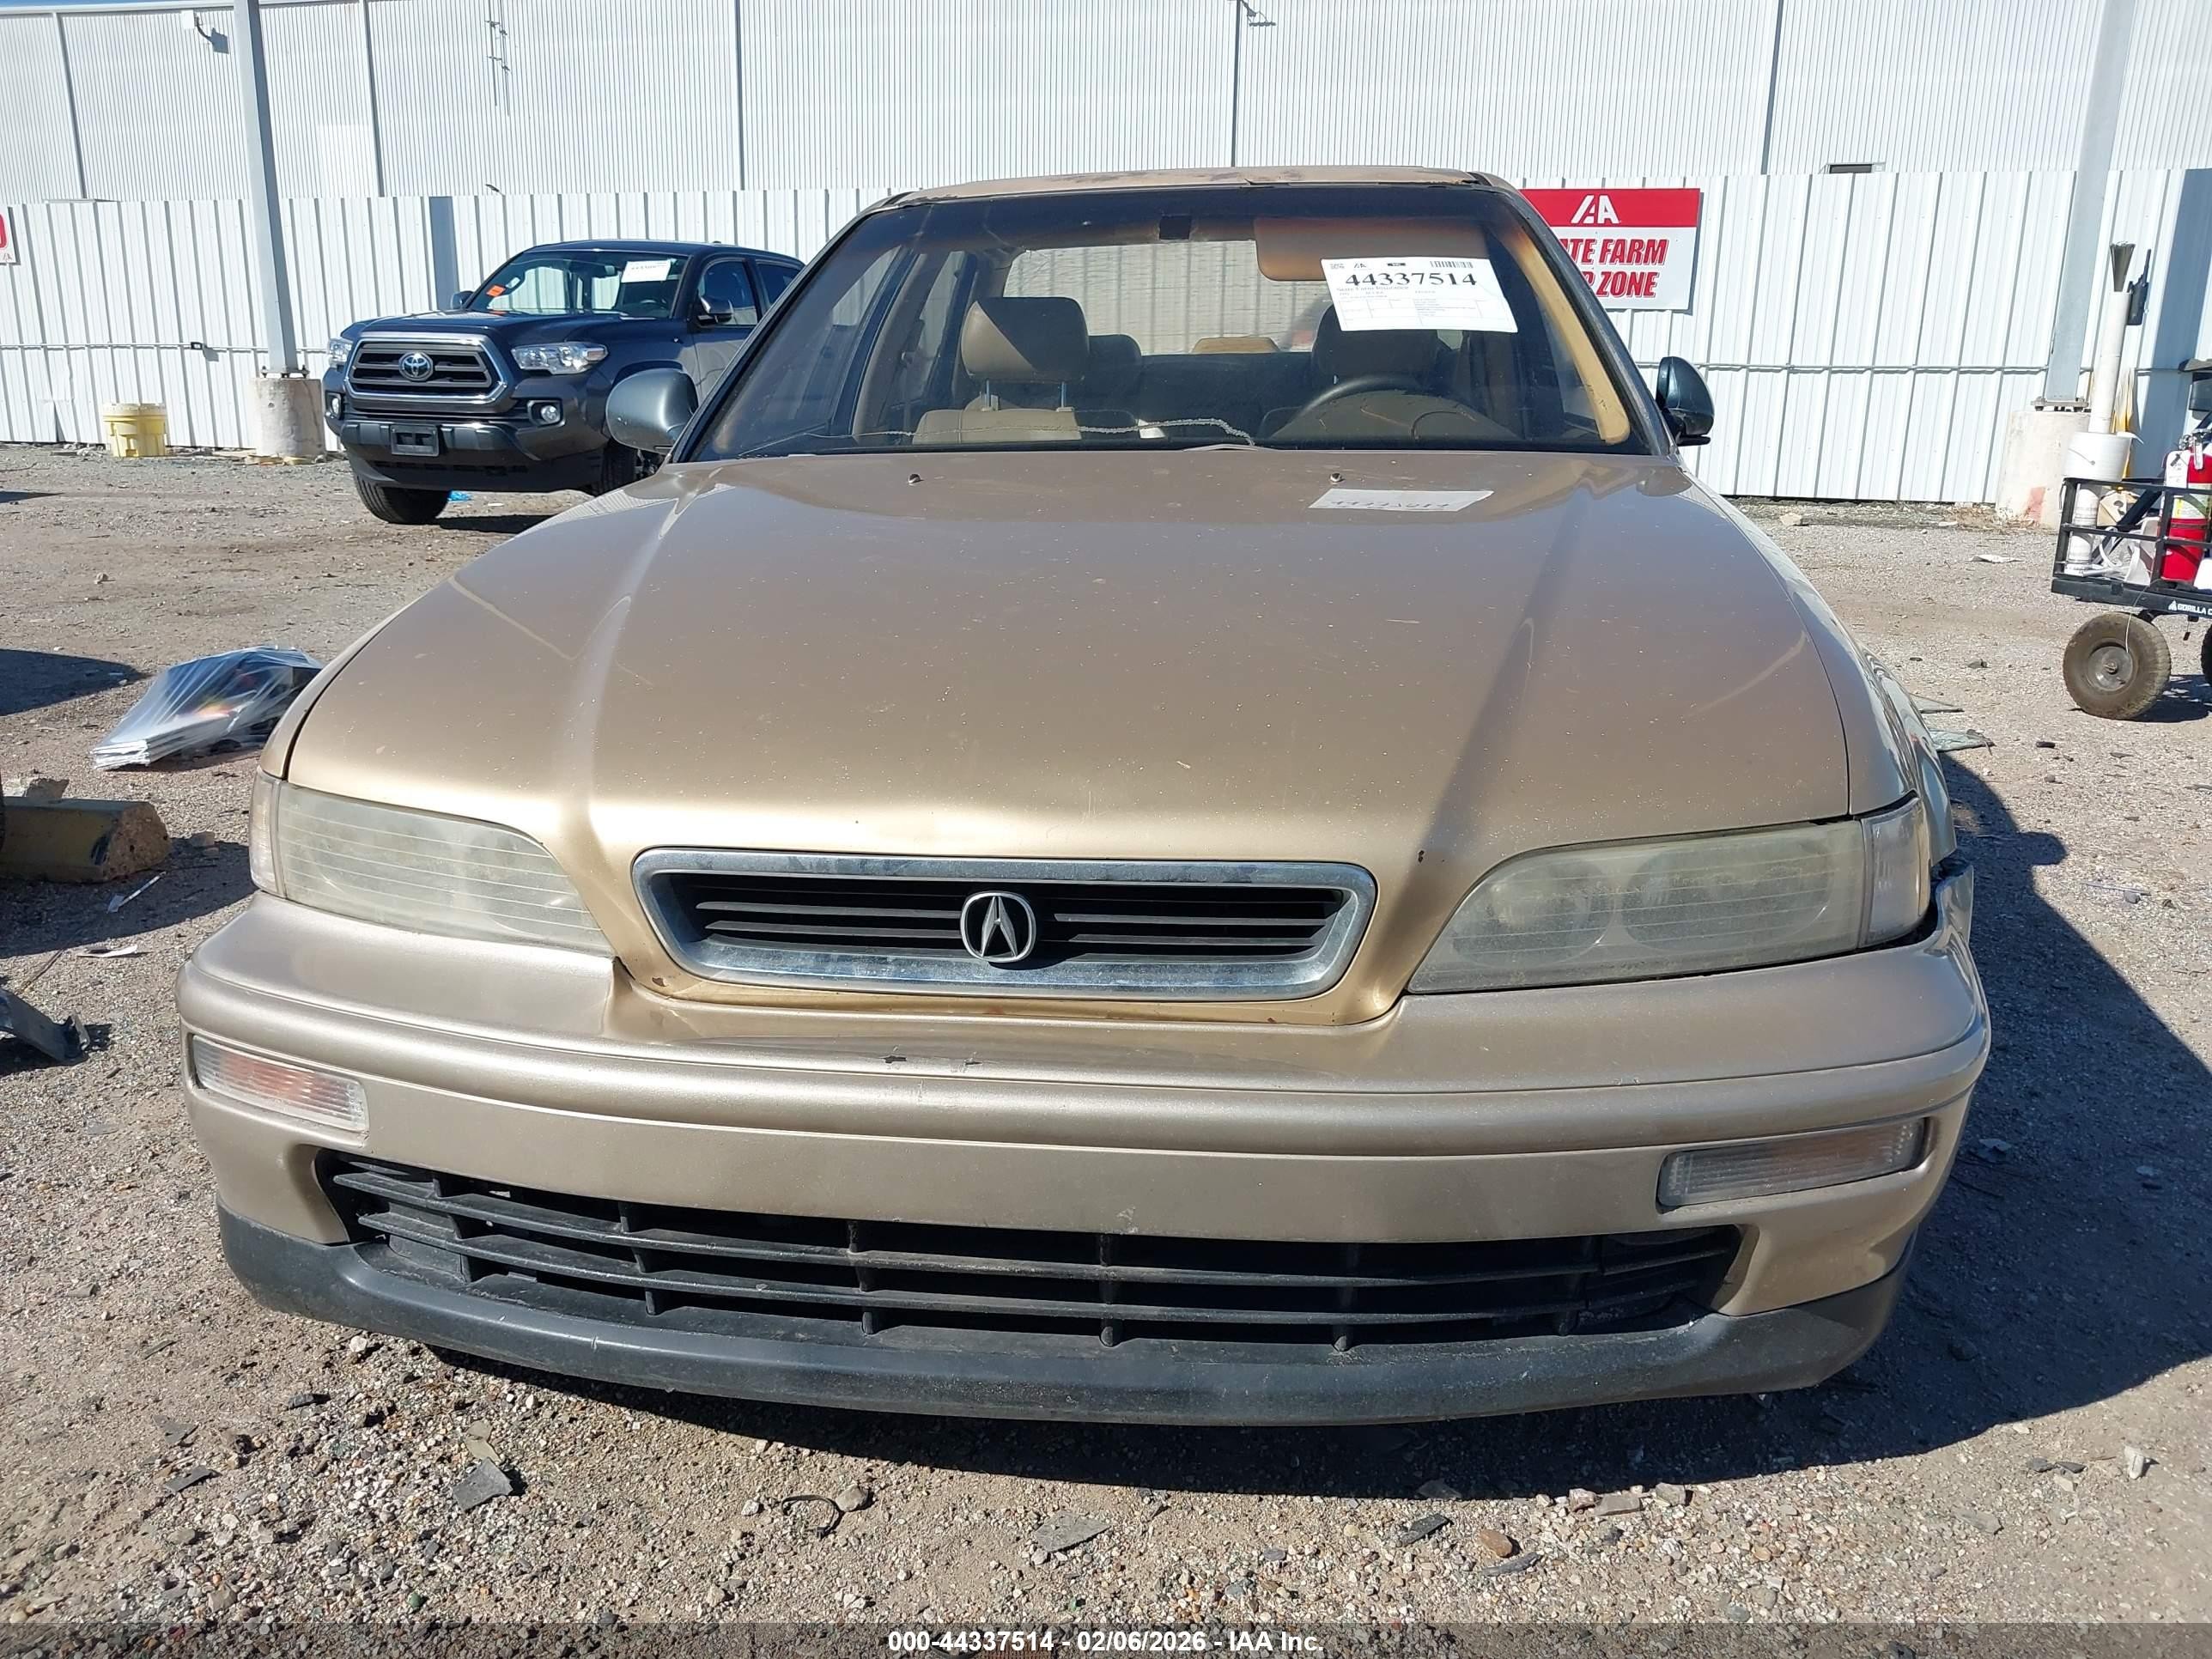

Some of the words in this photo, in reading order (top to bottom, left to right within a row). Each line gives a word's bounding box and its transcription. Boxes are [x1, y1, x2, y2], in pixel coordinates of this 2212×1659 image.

[1598, 239, 1669, 264] FARM
[1345, 272, 1477, 286] 44337514
[1596, 271, 1659, 296] ZONE
[2177, 603, 2206, 614] GORILLA
